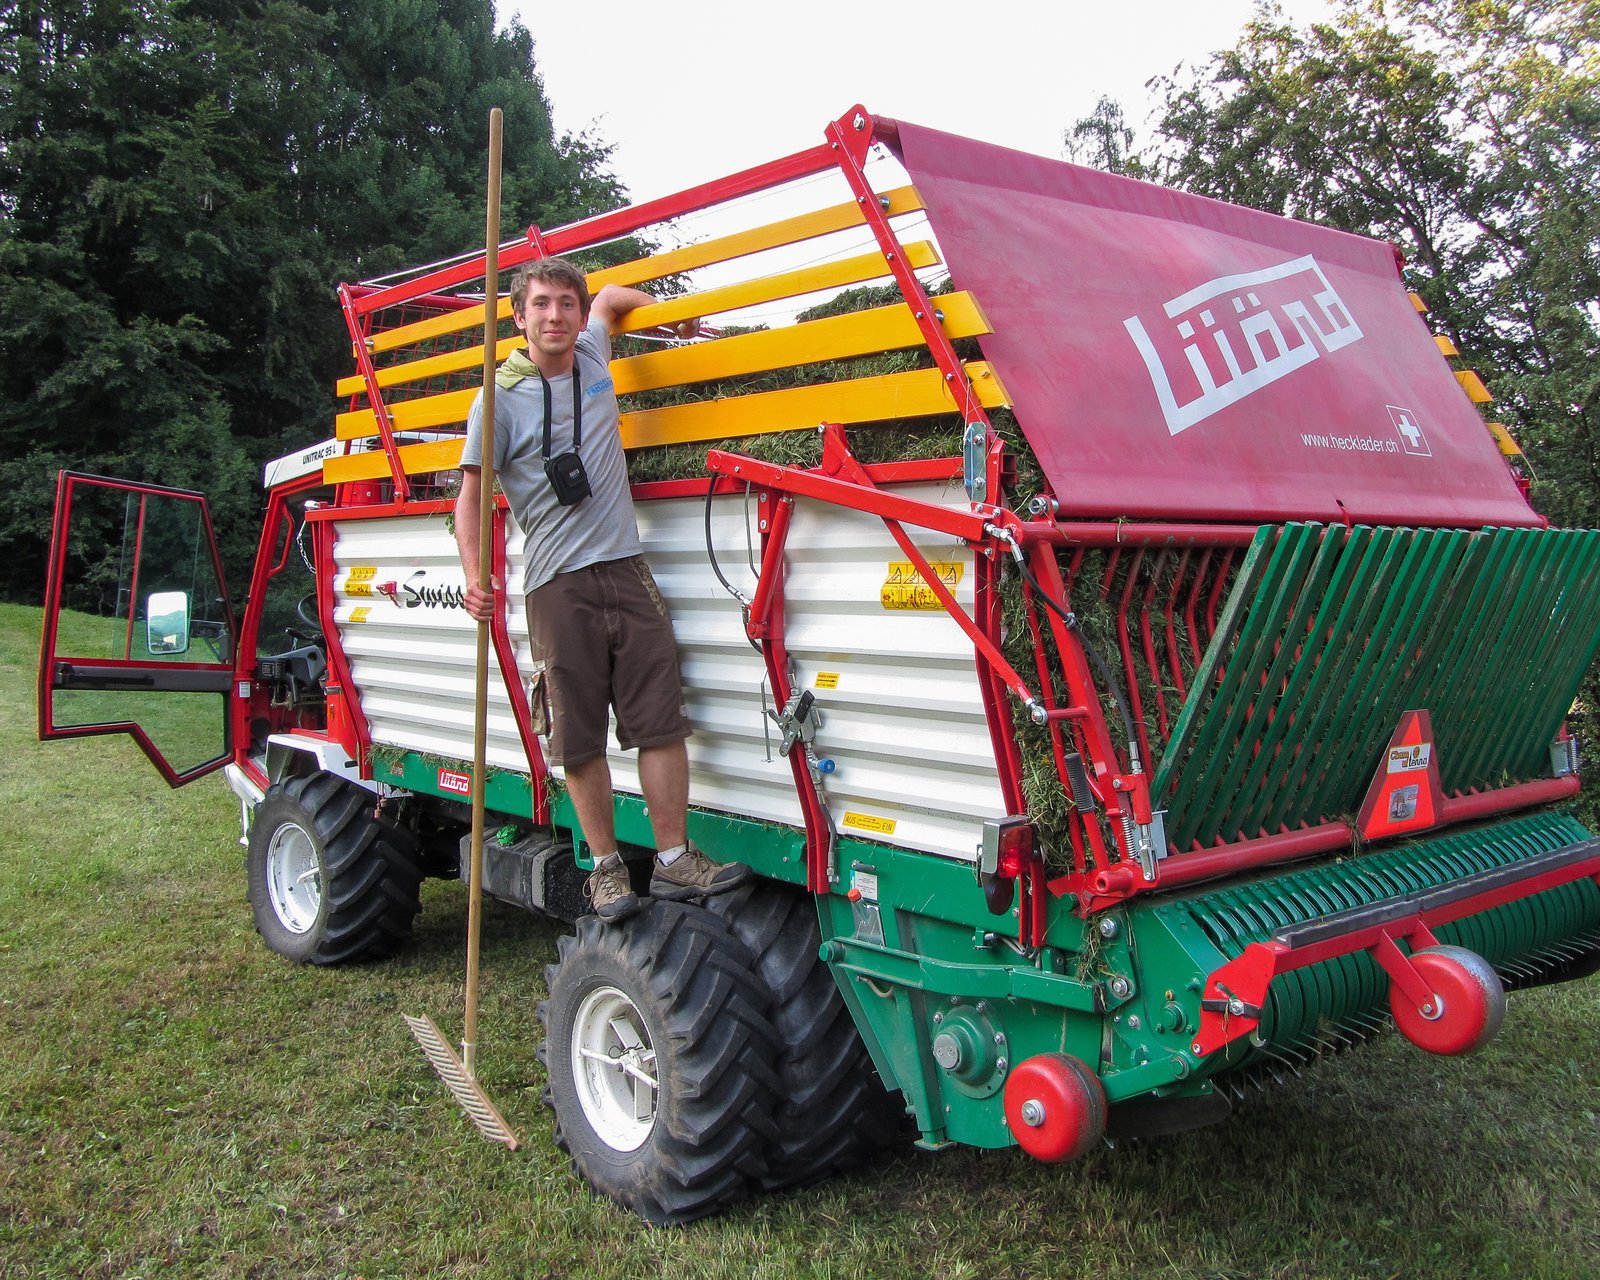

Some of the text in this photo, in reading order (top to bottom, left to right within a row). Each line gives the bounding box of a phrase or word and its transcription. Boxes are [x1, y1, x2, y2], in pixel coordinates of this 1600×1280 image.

[1300, 432, 1400, 453] www.hecklader.ch
[302, 449, 324, 464] UNITRAC
[402, 570, 466, 609] Swiss
[845, 815, 893, 831] AUS EIN
